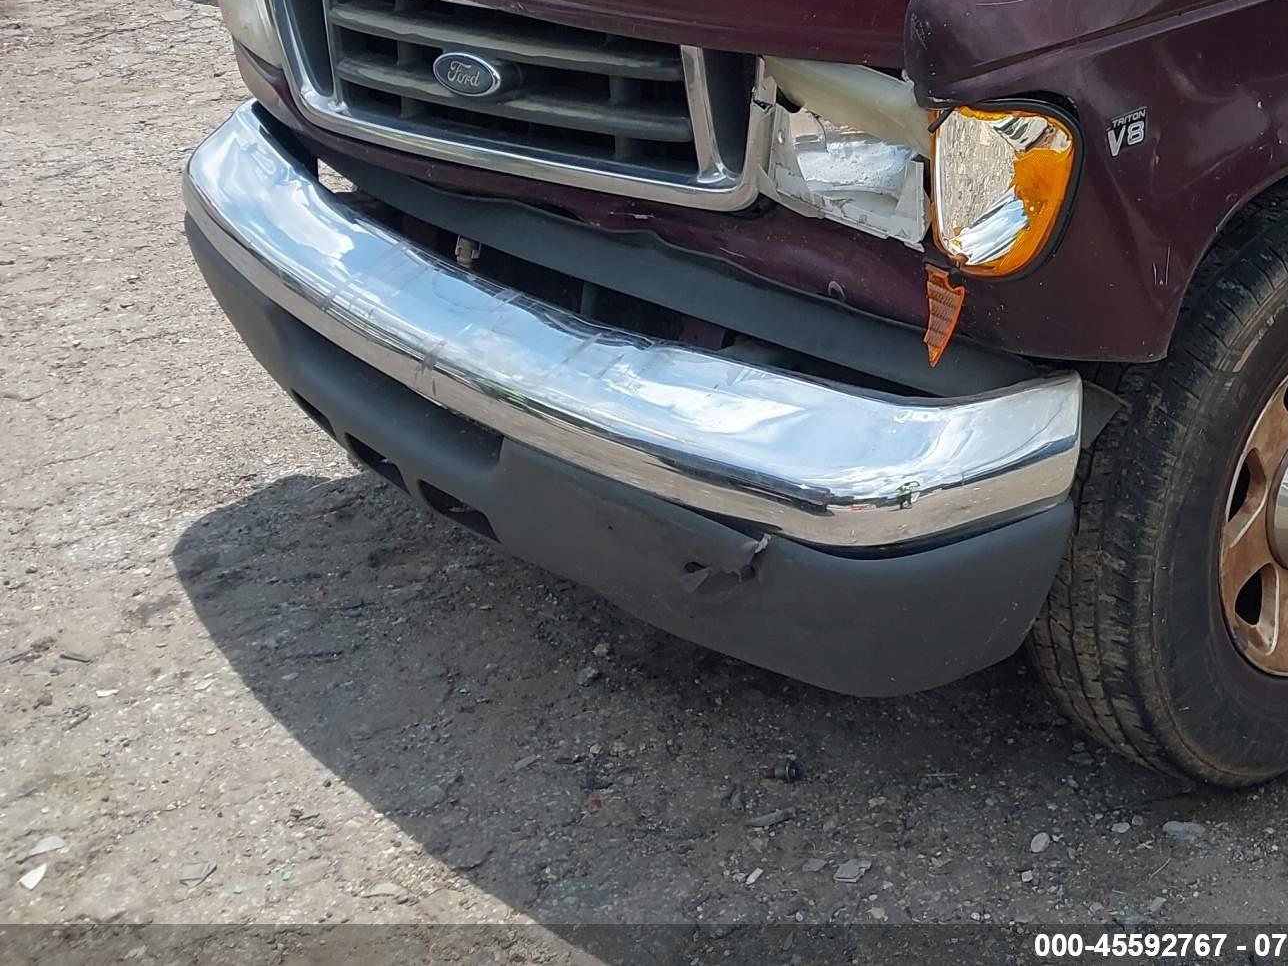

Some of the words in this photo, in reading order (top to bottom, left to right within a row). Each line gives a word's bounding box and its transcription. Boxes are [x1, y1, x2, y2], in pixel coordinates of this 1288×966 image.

[447, 60, 481, 87] Ford
[1111, 108, 1146, 128] TRITON
[1107, 120, 1145, 157] V8
